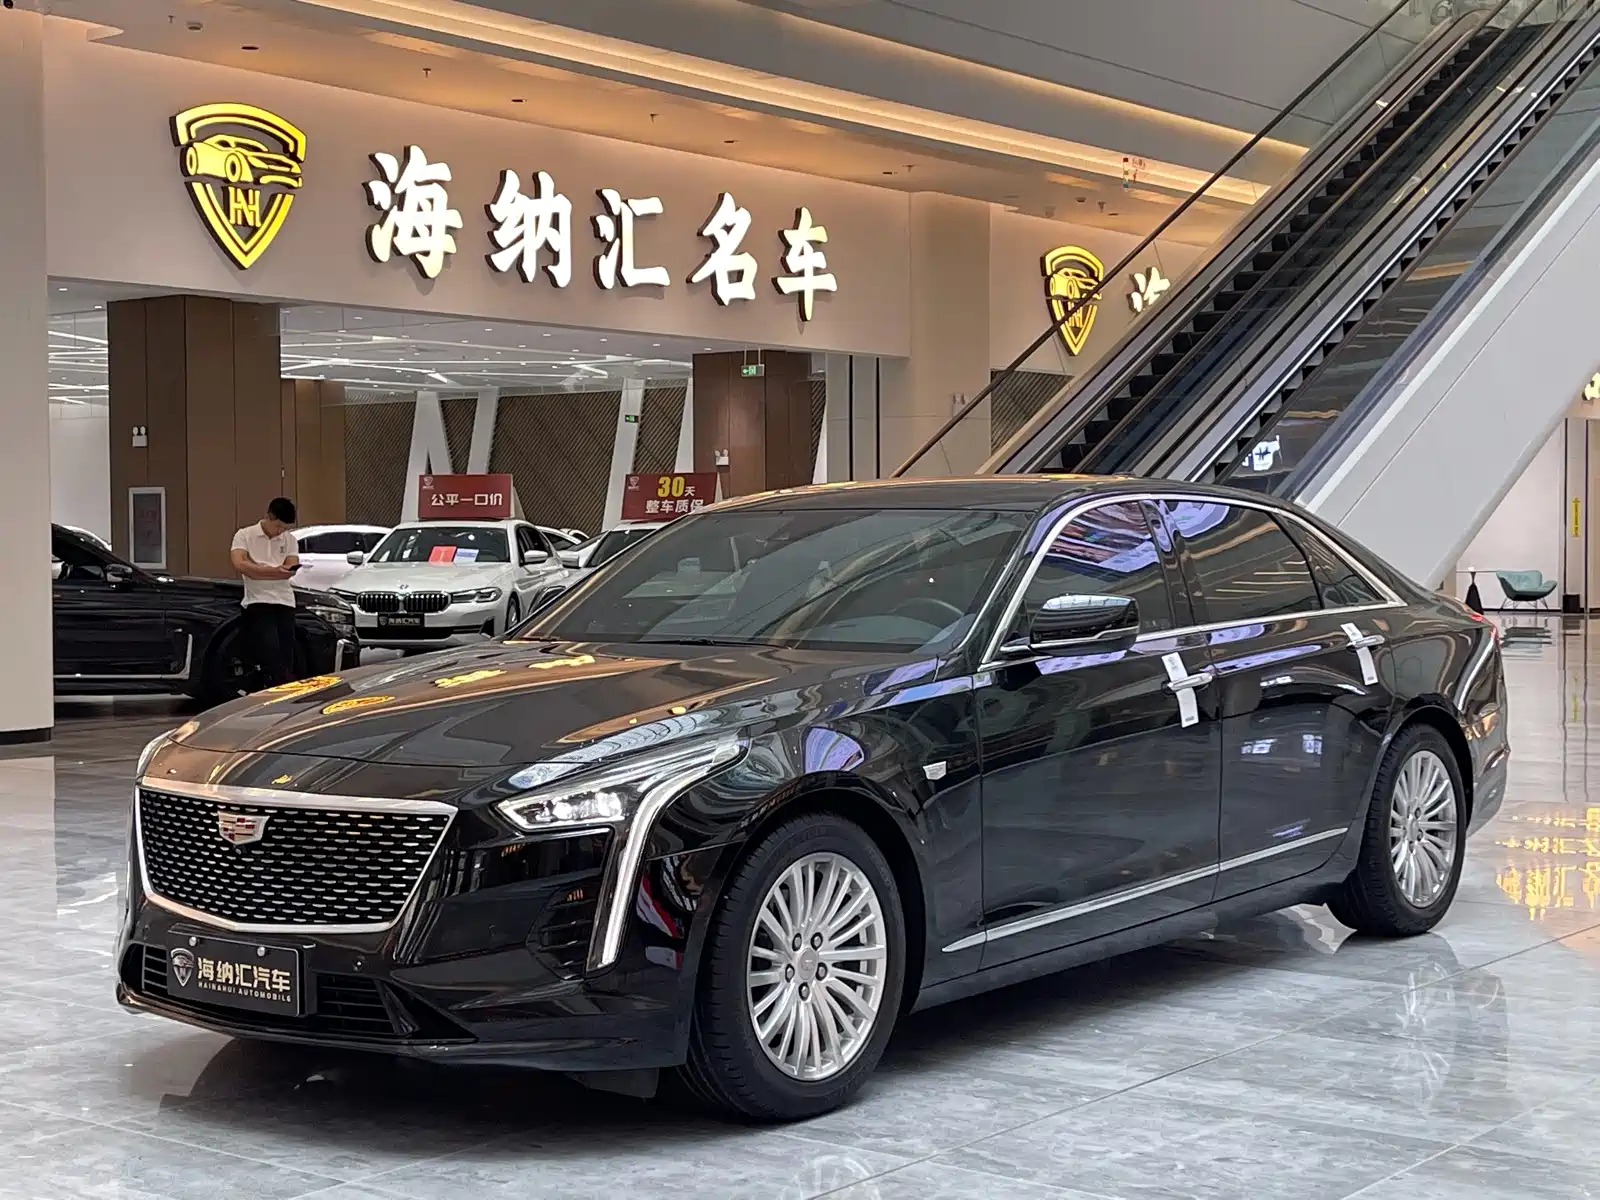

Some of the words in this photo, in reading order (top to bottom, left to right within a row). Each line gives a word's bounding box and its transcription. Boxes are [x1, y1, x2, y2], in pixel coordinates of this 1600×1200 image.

[363, 145, 838, 321] 海纳汇名车
[431, 493, 503, 506] 公平一口价
[197, 956, 291, 992] 海纳汇汽车
